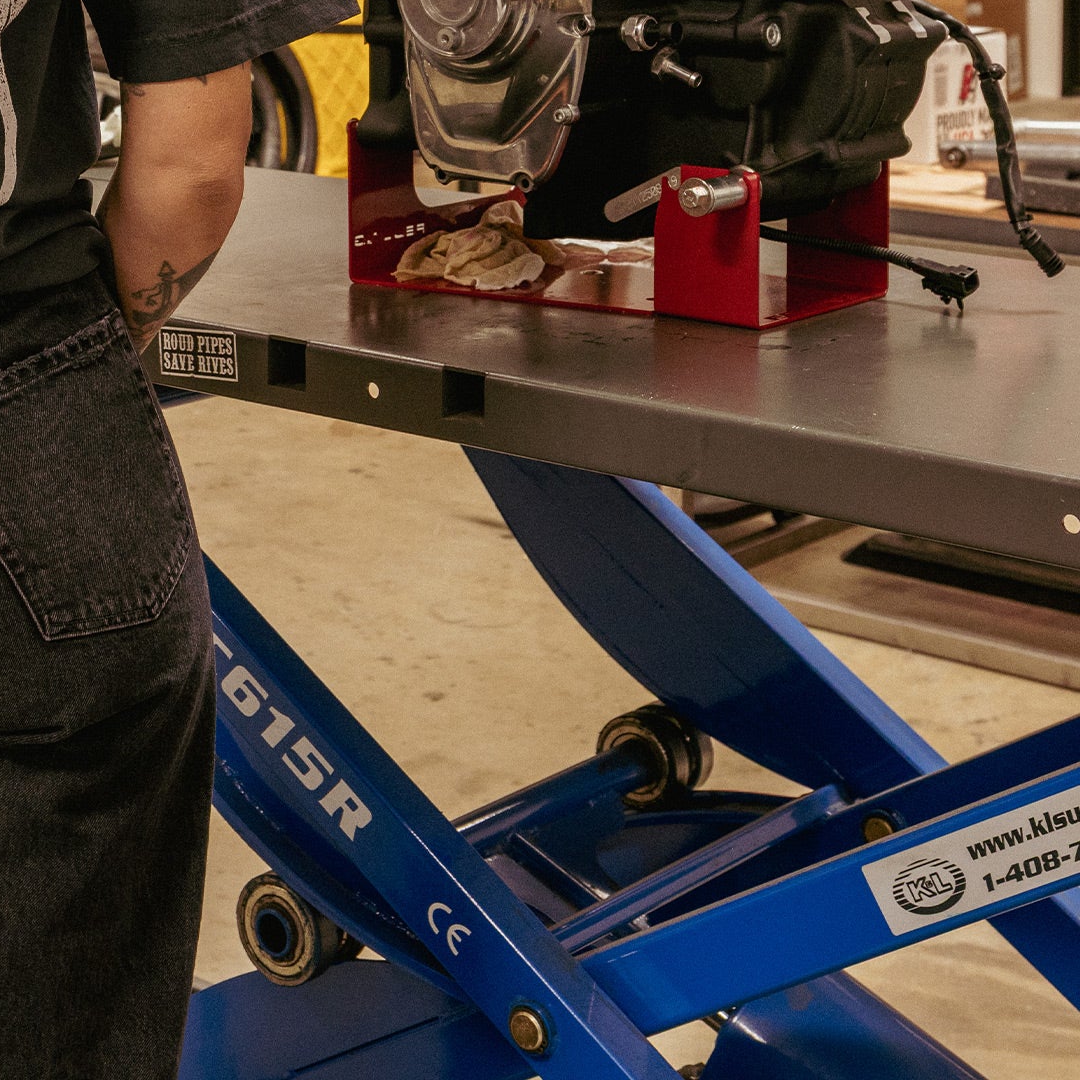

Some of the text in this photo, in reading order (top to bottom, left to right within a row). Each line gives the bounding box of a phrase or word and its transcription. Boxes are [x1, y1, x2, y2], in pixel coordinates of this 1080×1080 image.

[197, 335, 233, 356] PIPES
[163, 351, 234, 376] SAVE RIVES
[213, 632, 372, 842] 615R
